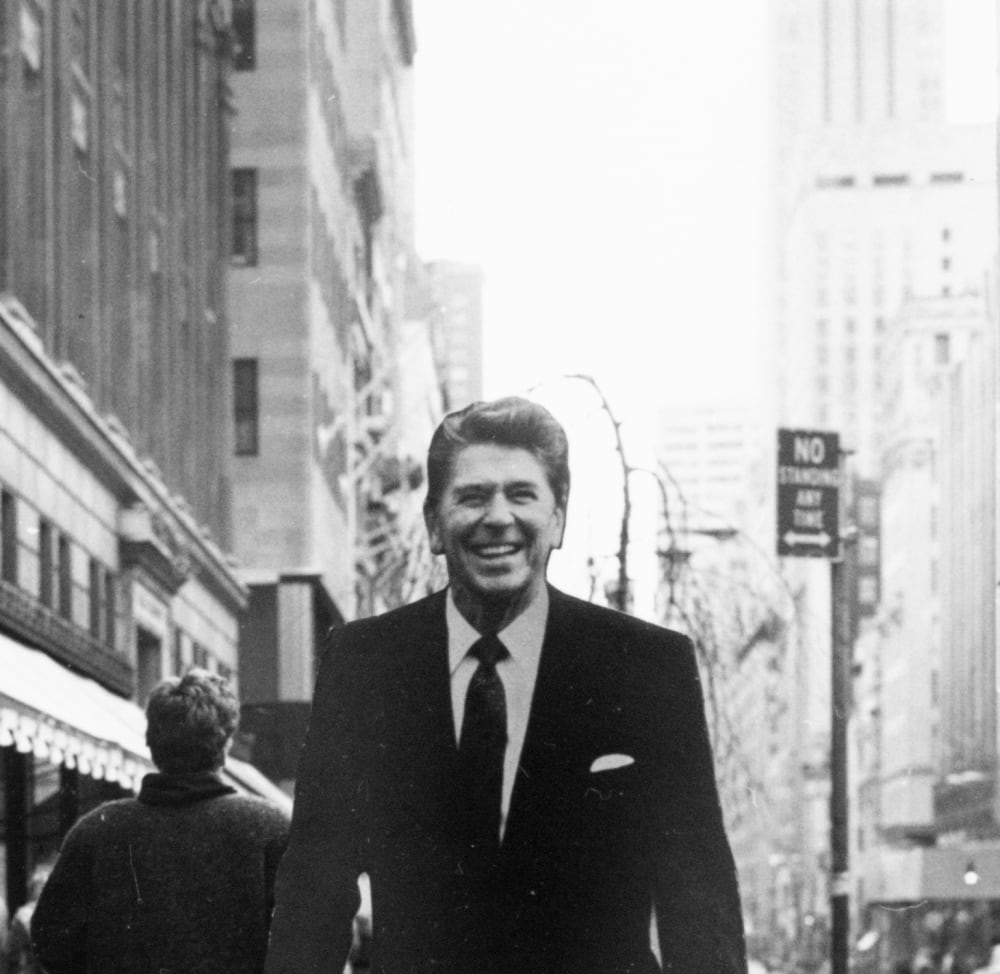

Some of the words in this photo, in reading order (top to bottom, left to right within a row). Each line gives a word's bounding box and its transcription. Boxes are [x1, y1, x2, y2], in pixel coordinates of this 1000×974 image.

[793, 437, 825, 464] NO
[779, 466, 839, 487] STANDING
[796, 489, 822, 507] ANY
